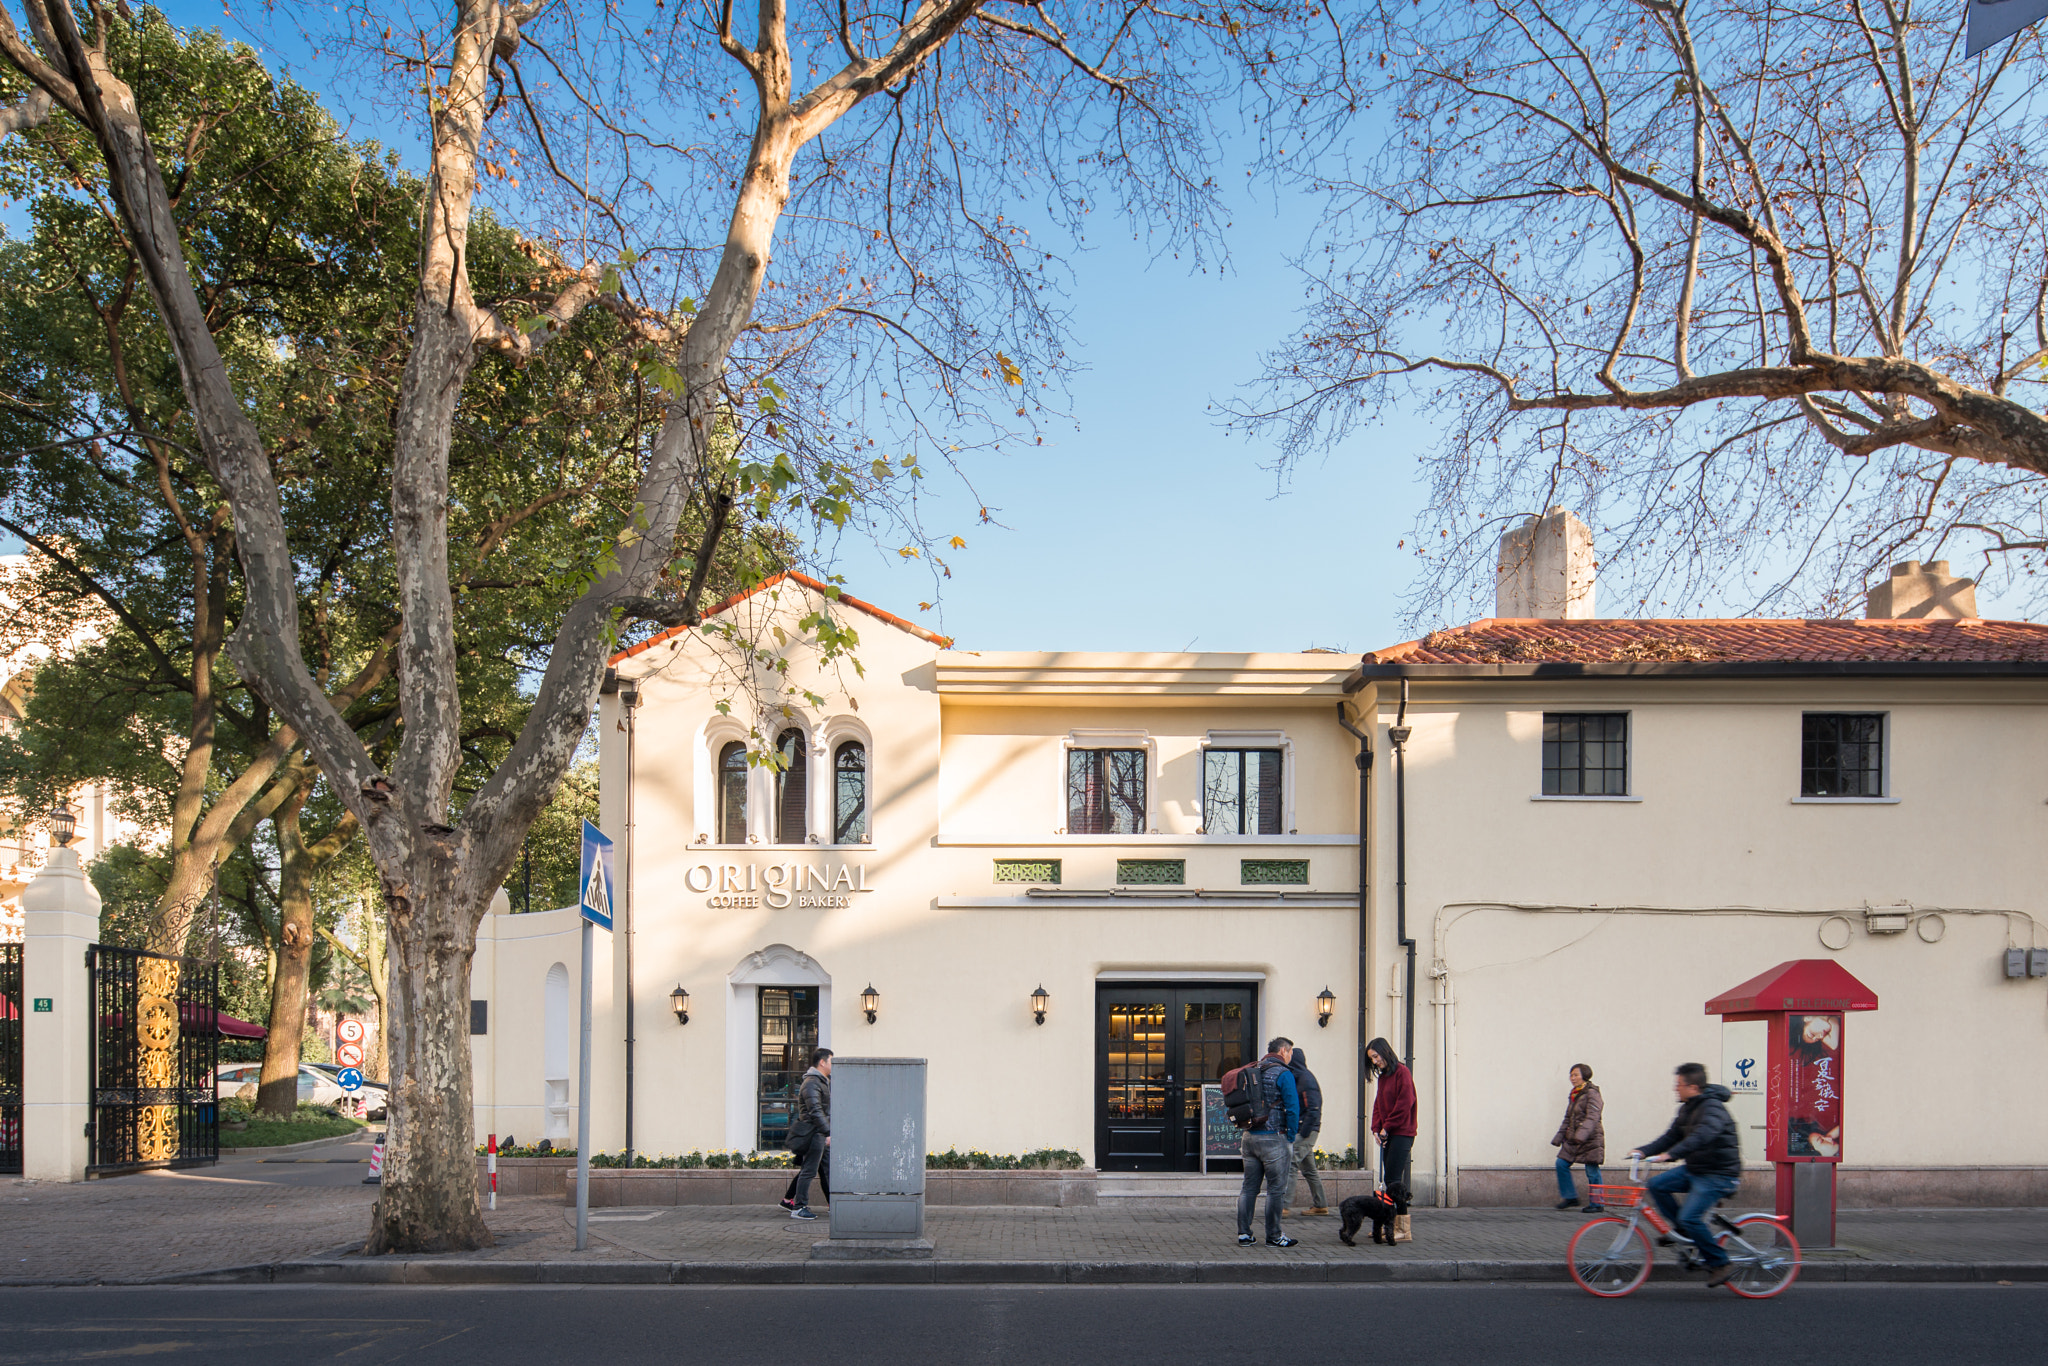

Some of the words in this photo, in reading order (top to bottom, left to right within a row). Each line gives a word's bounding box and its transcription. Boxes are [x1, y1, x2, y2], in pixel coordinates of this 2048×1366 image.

[710, 895, 759, 908] COFFEE
[799, 895, 852, 908] BAKERY
[38, 999, 49, 1007] 45
[1796, 998, 1852, 1009] TELEPHONE
[347, 1025, 356, 1037] 5
